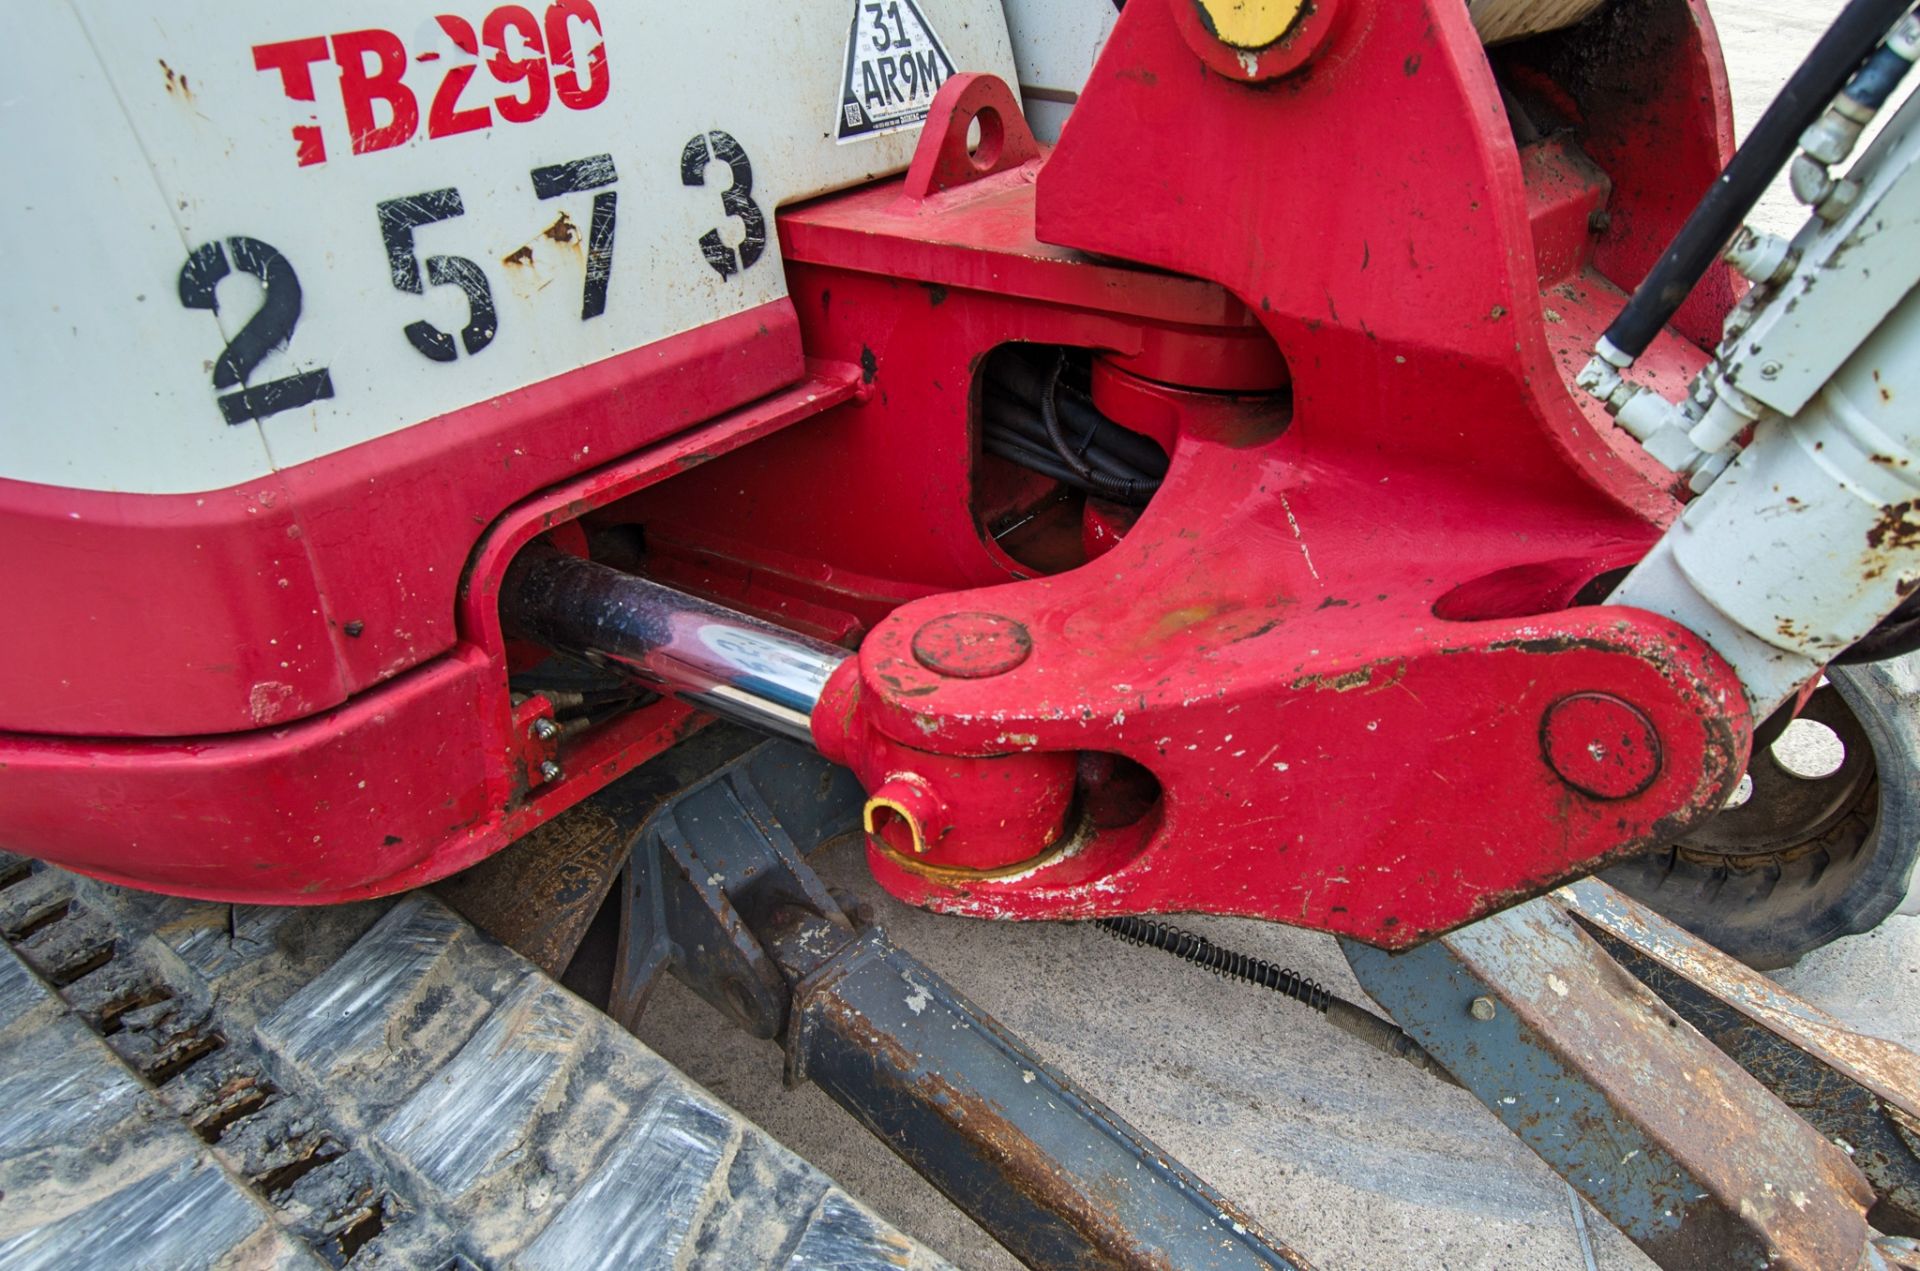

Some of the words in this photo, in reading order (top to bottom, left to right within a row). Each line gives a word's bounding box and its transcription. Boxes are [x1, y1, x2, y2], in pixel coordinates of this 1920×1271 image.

[865, 1, 912, 51] 31
[252, 0, 610, 167] TB290
[861, 49, 941, 110] AR9M
